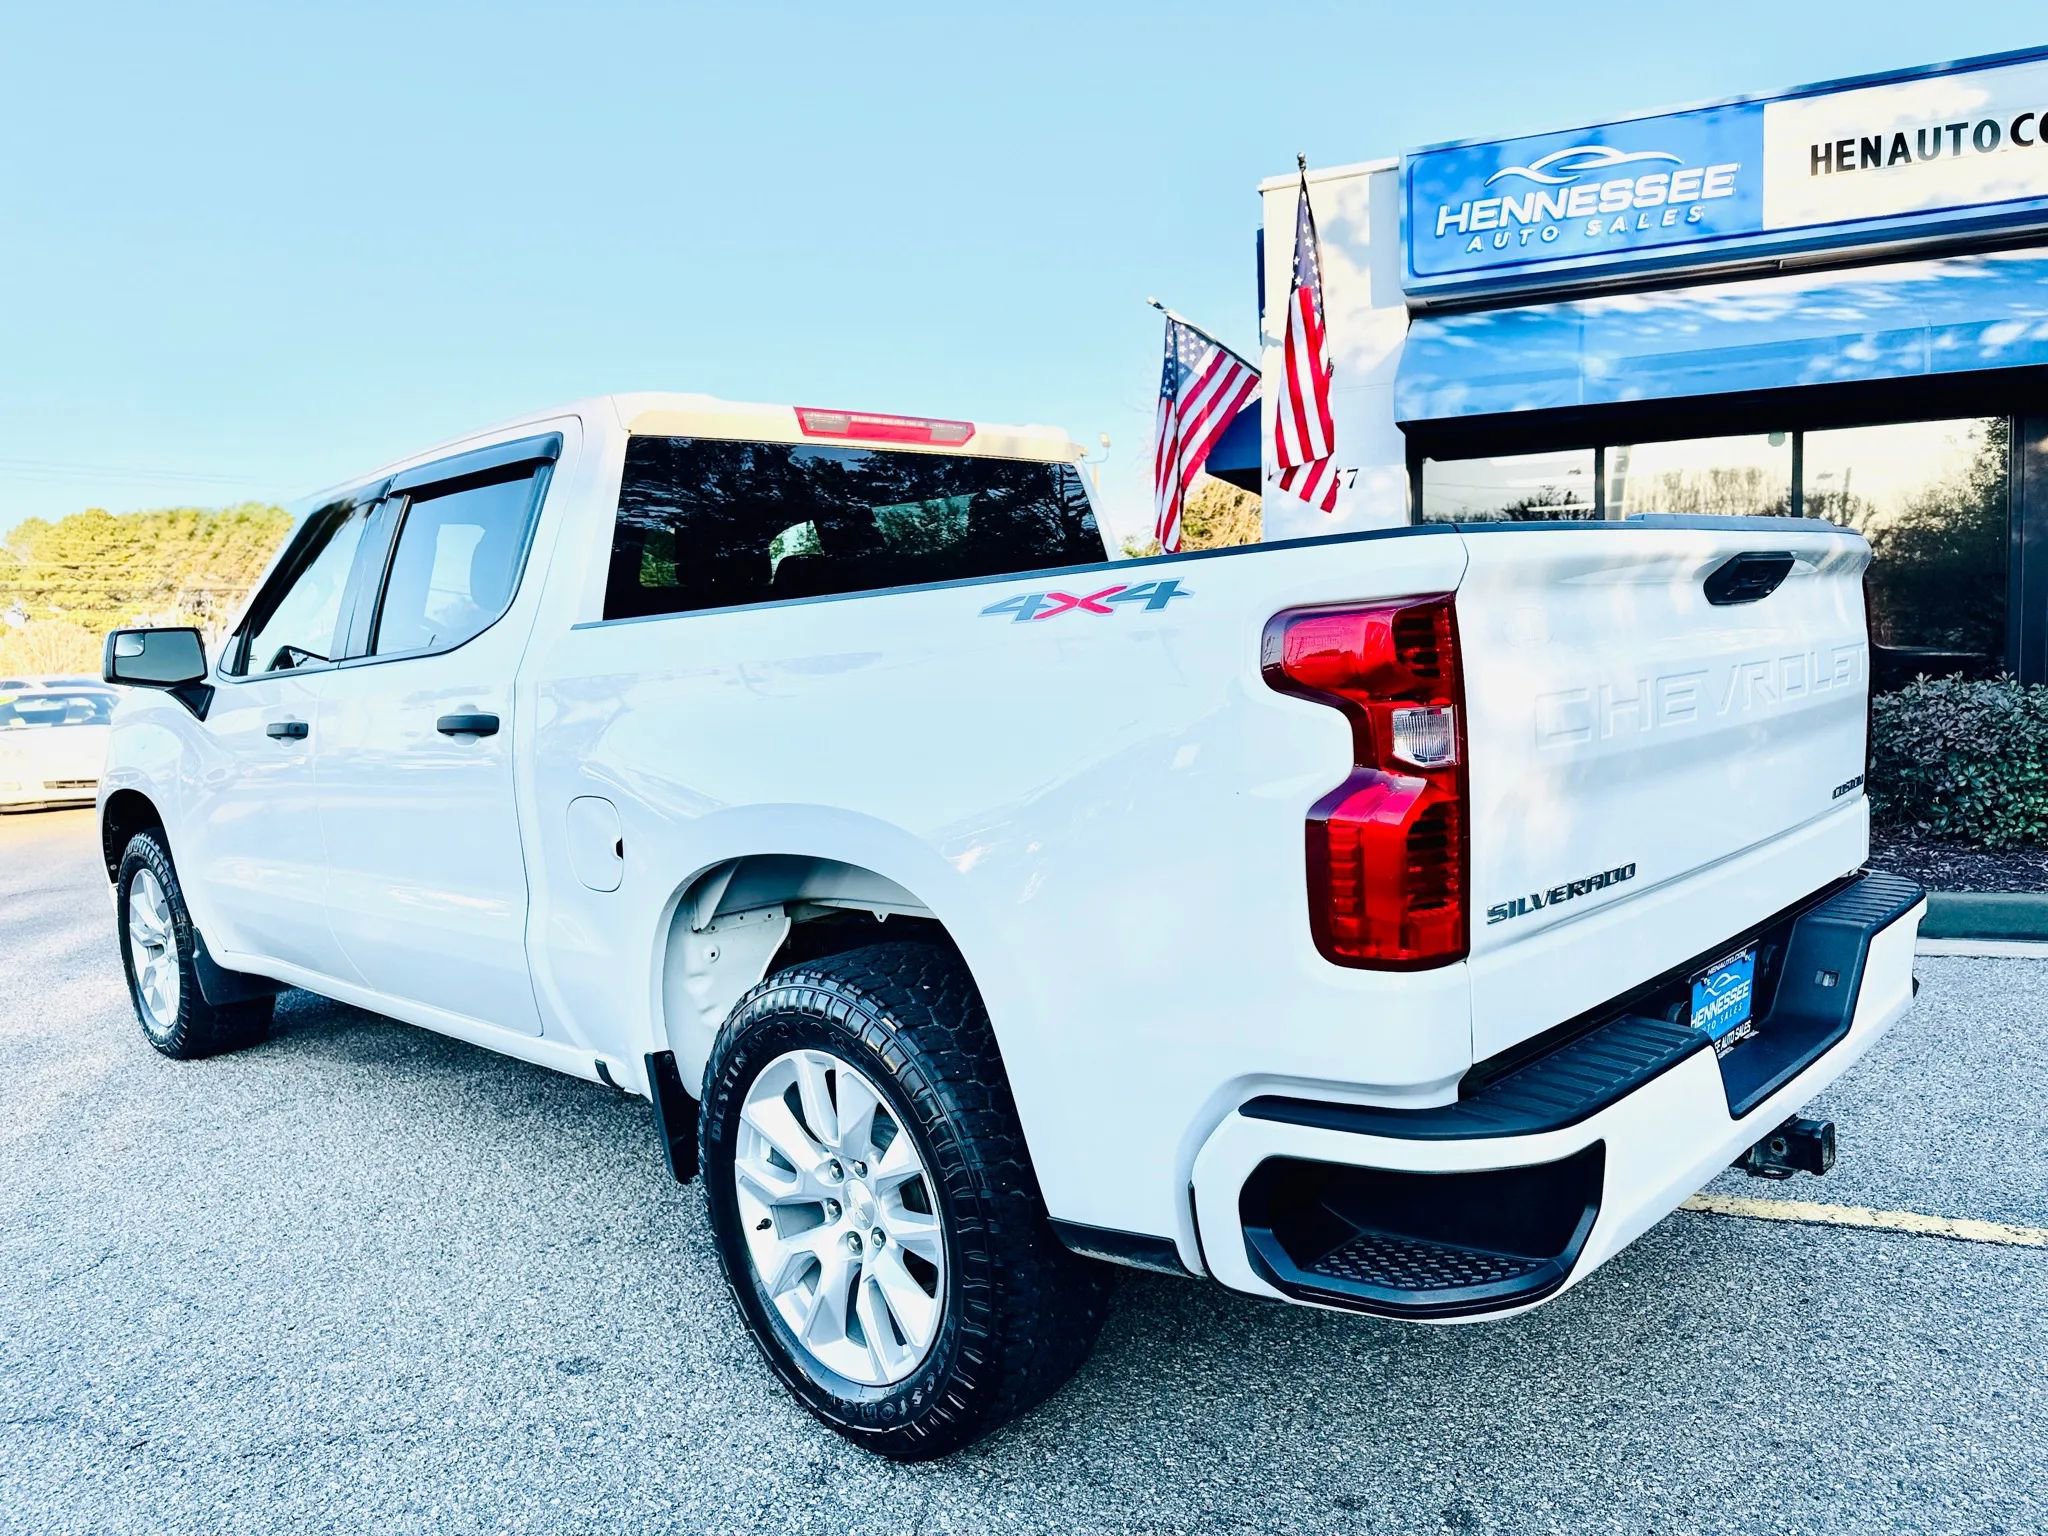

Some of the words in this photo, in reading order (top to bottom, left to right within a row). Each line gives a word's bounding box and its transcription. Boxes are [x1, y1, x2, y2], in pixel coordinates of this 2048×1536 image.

[1435, 163, 1740, 236] HENNESSEE
[1466, 225, 1560, 253] AUTO
[1585, 206, 1706, 236] SALES
[1535, 643, 1867, 750] CHEVROLET
[1487, 863, 1636, 925] SILVERADO
[1691, 979, 1750, 1029] HENNESSEE
[1720, 1003, 1743, 1025] SALES
[1735, 1019, 1752, 1041] SALES
